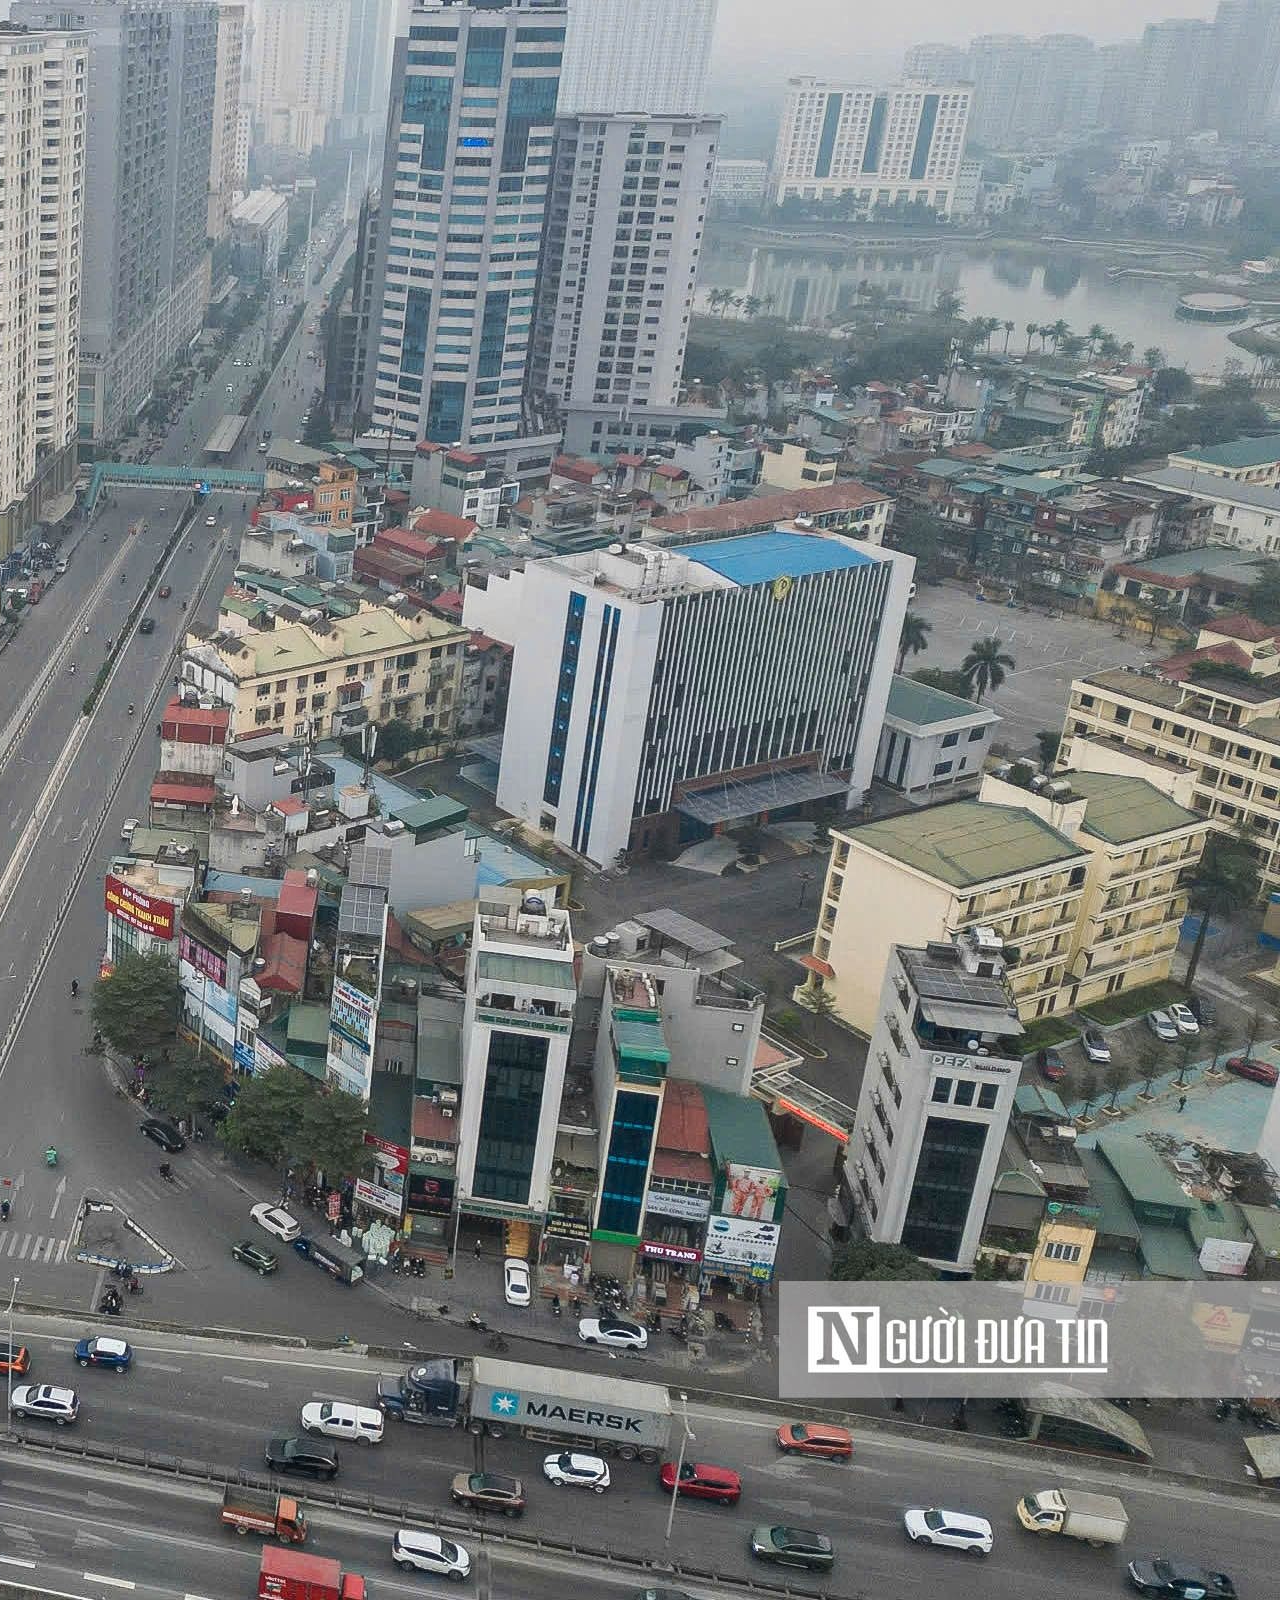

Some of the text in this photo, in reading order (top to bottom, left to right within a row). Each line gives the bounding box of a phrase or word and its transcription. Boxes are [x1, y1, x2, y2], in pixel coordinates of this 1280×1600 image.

[932, 1055, 972, 1069] DEFA
[665, 1248, 697, 1260] TRANG
[526, 1401, 643, 1434] MAERSK
